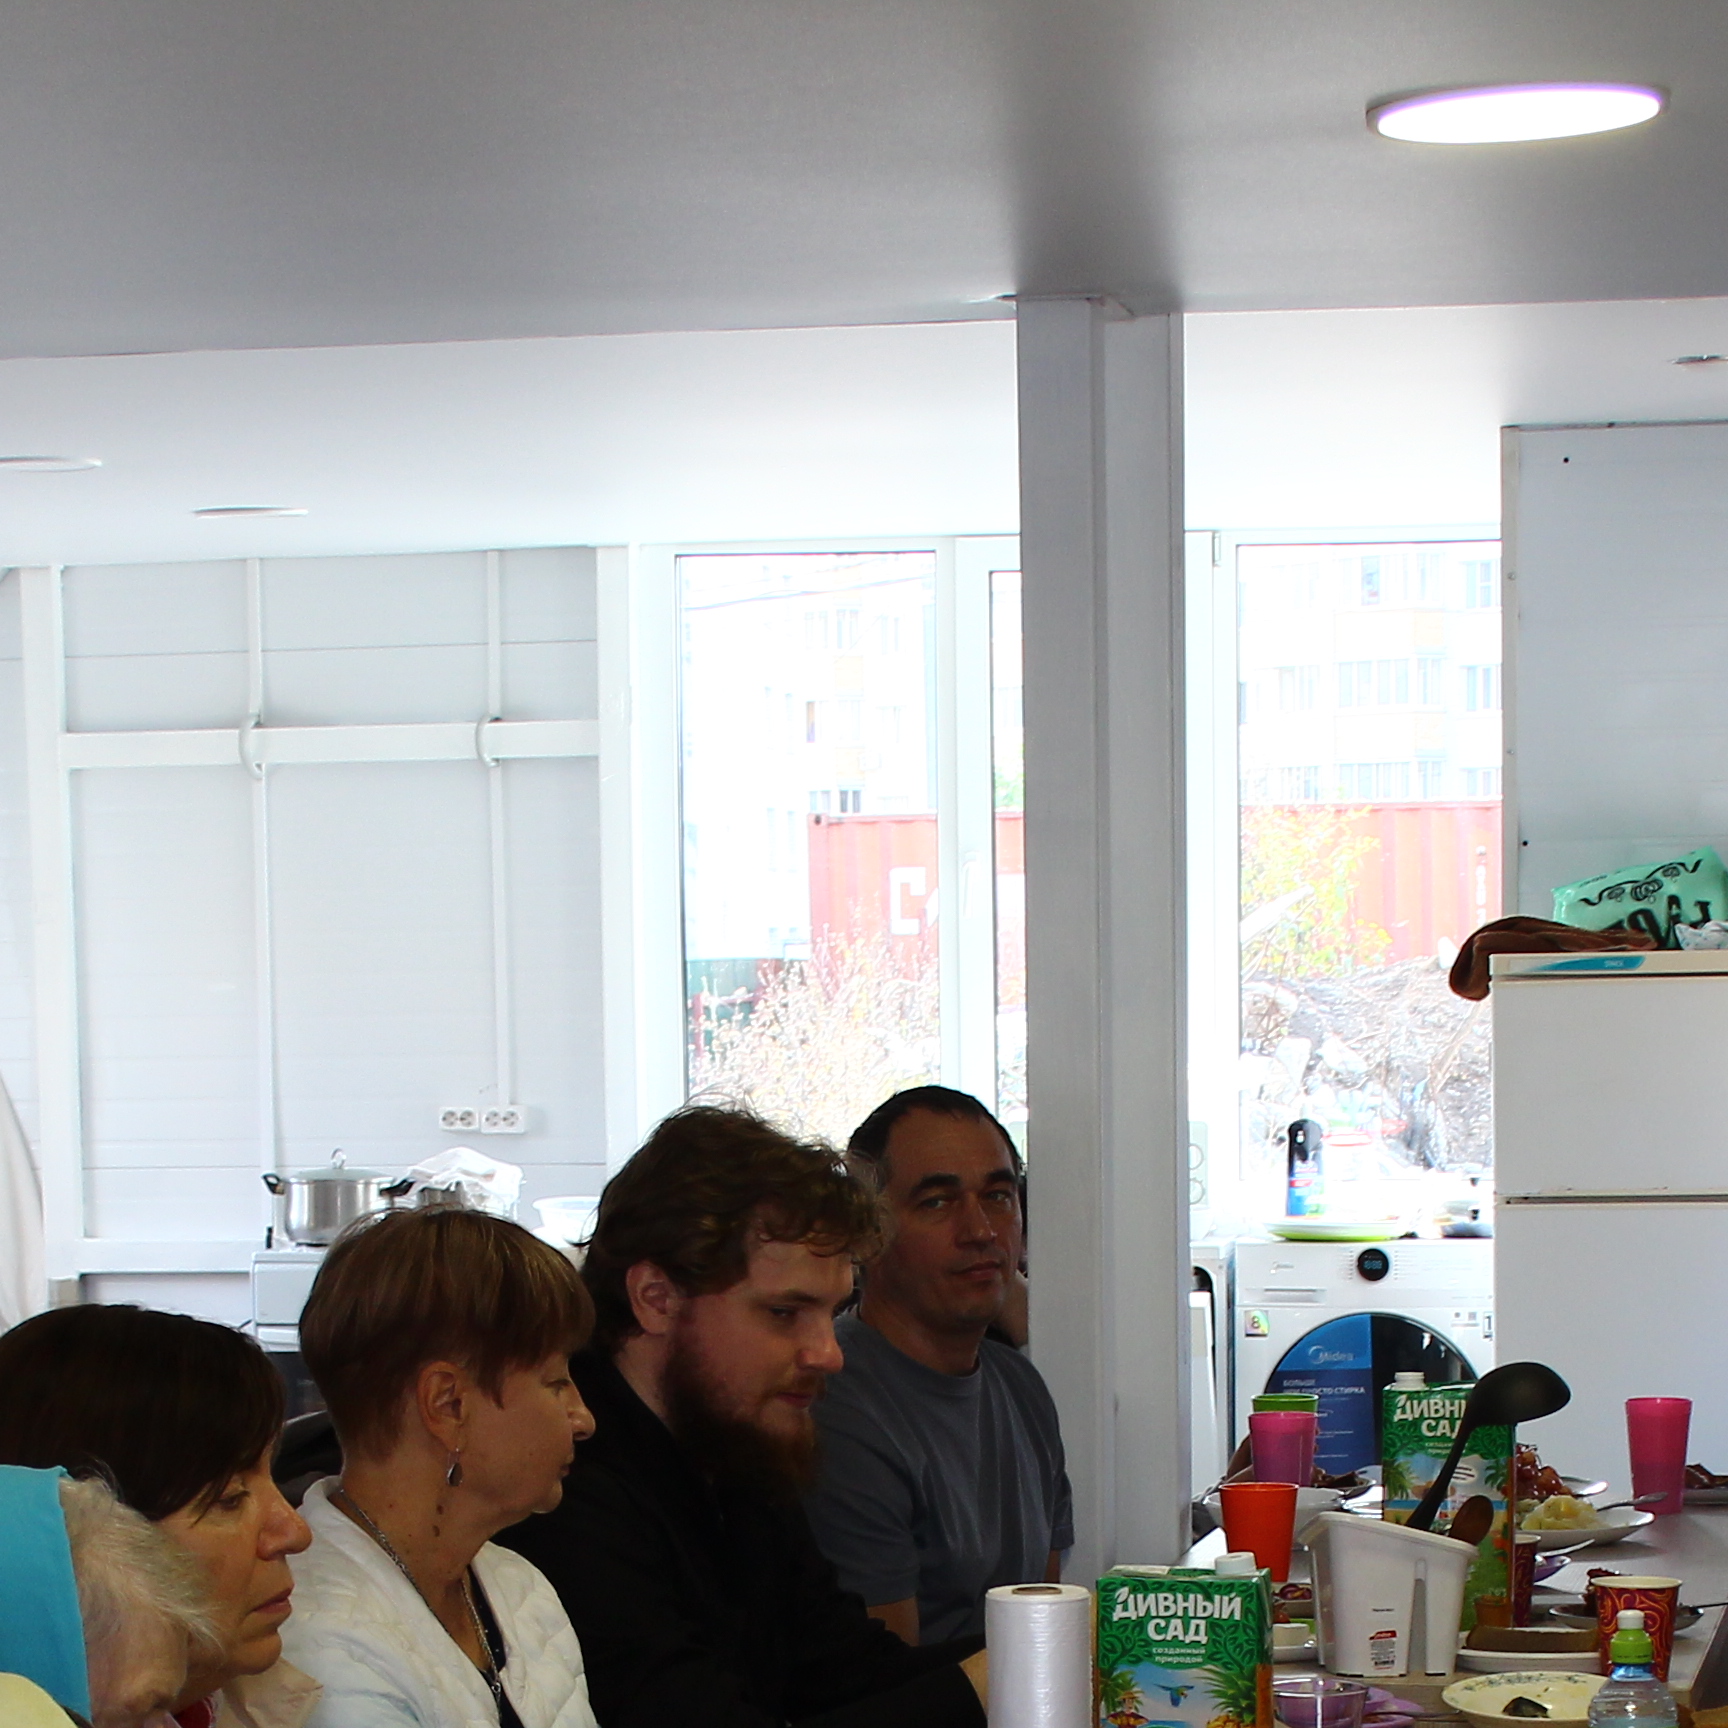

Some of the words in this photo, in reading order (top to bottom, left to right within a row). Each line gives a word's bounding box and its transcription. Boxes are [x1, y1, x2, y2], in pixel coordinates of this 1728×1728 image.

[1393, 1394, 1466, 1422] ДИВН
[1113, 1586, 1242, 1621] ДИВНЫЙ
[1147, 1618, 1209, 1645] САД
